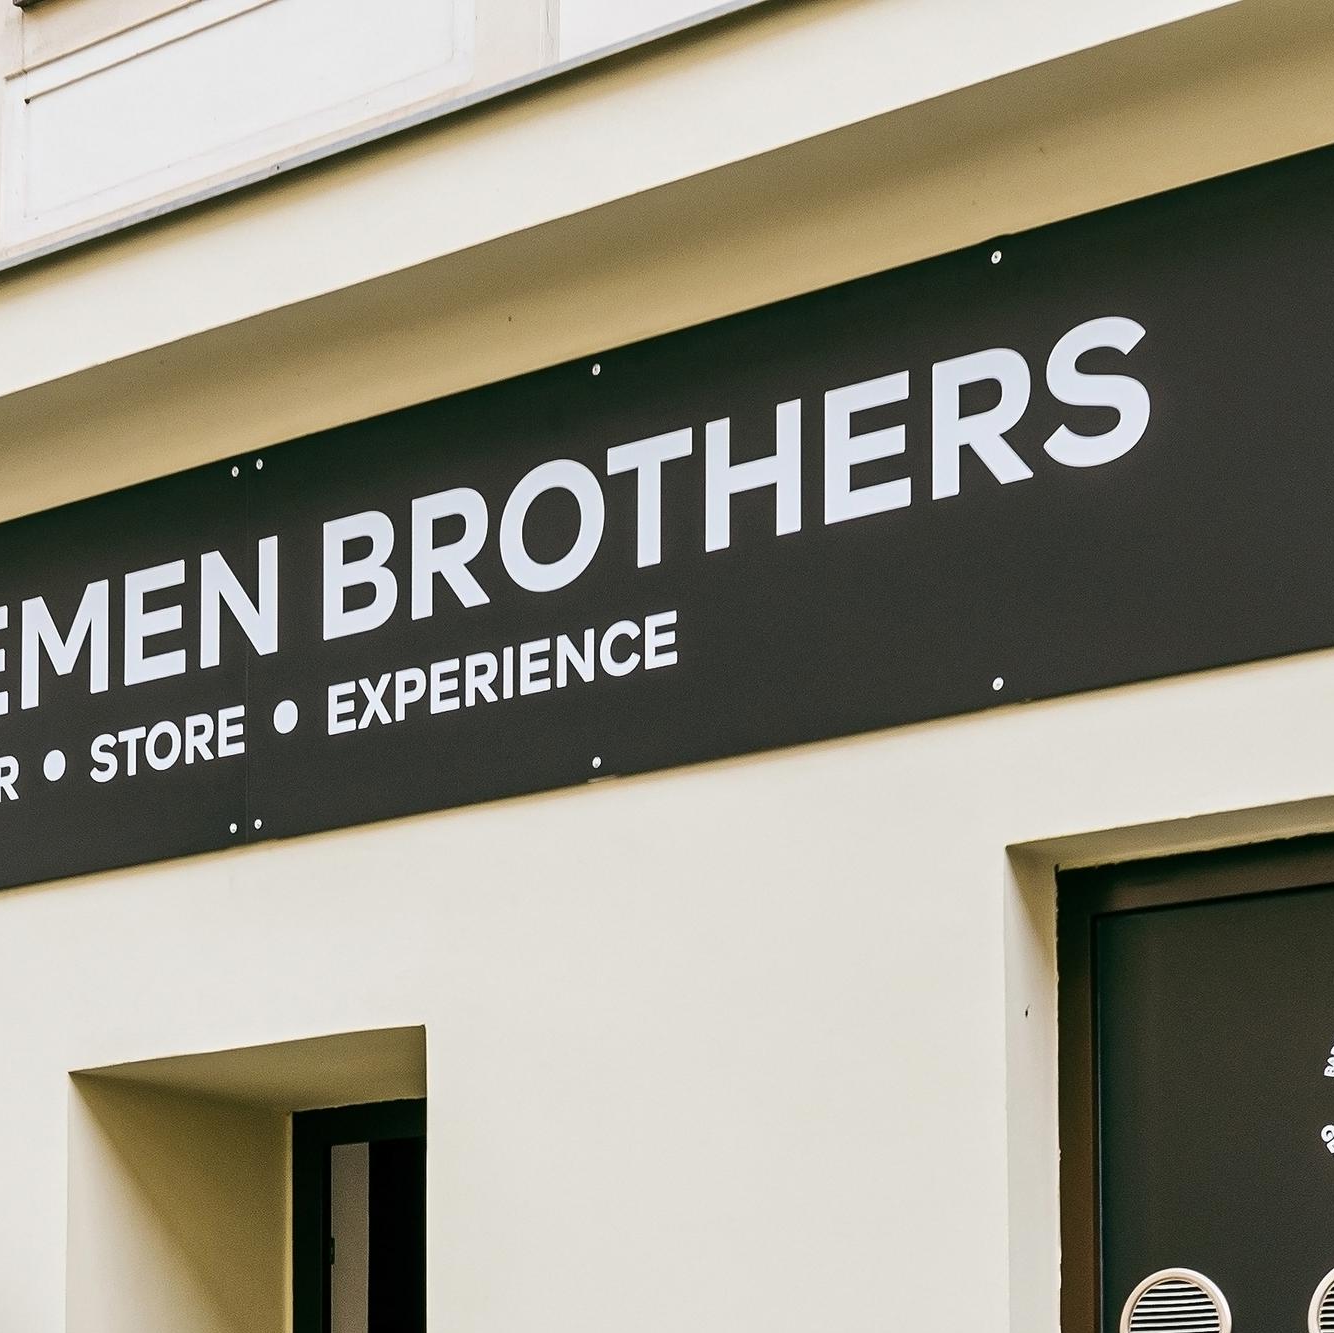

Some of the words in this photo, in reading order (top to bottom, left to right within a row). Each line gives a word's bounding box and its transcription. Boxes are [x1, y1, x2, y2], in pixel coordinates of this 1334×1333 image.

[322, 316, 1152, 641] BROTHERS
[89, 704, 246, 783] STORE
[327, 609, 678, 736] EXPERIENCE
